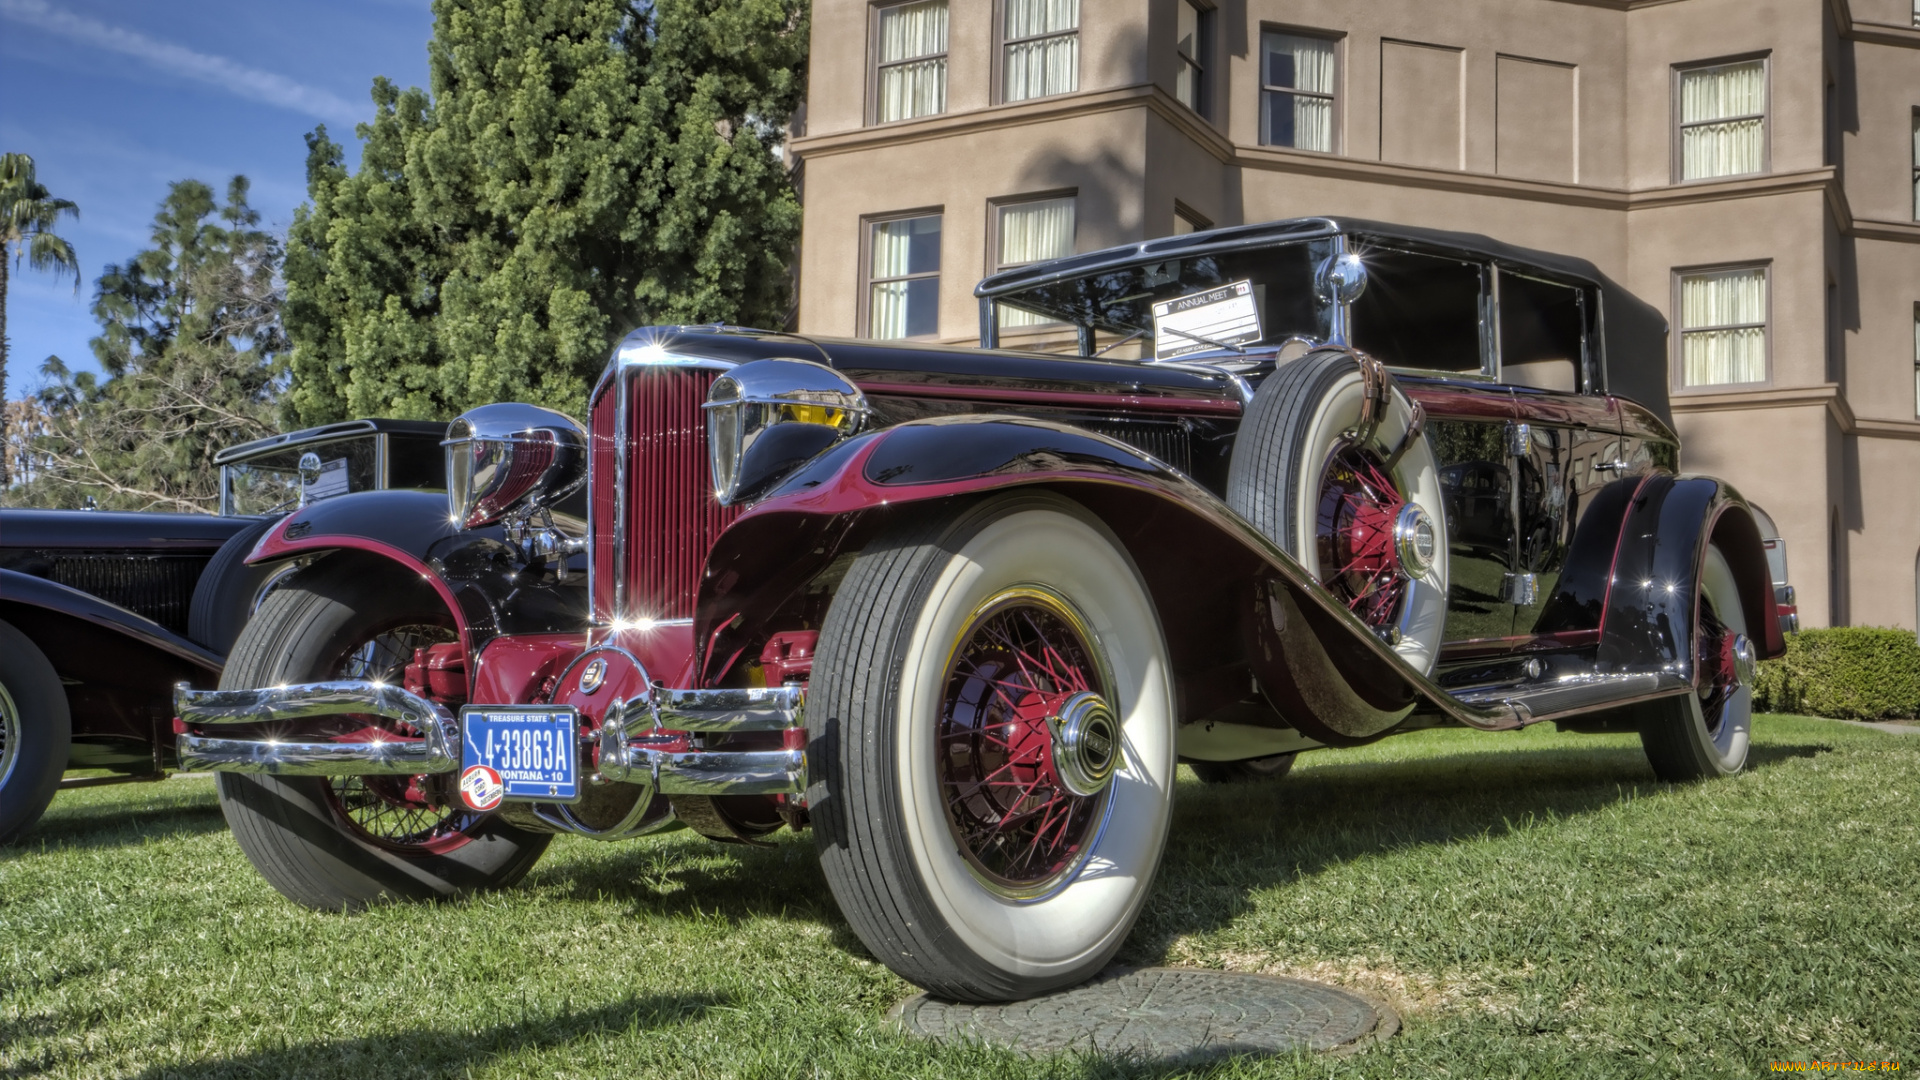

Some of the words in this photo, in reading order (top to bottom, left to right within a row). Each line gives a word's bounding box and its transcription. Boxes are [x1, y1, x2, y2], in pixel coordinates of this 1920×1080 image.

[1177, 296, 1208, 310] ANNUAL
[1208, 290, 1227, 302] MEET
[489, 715, 525, 723] TREASURE
[526, 715, 547, 723] STATE
[463, 769, 480, 787] AUBURN
[550, 771, 563, 781] 10
